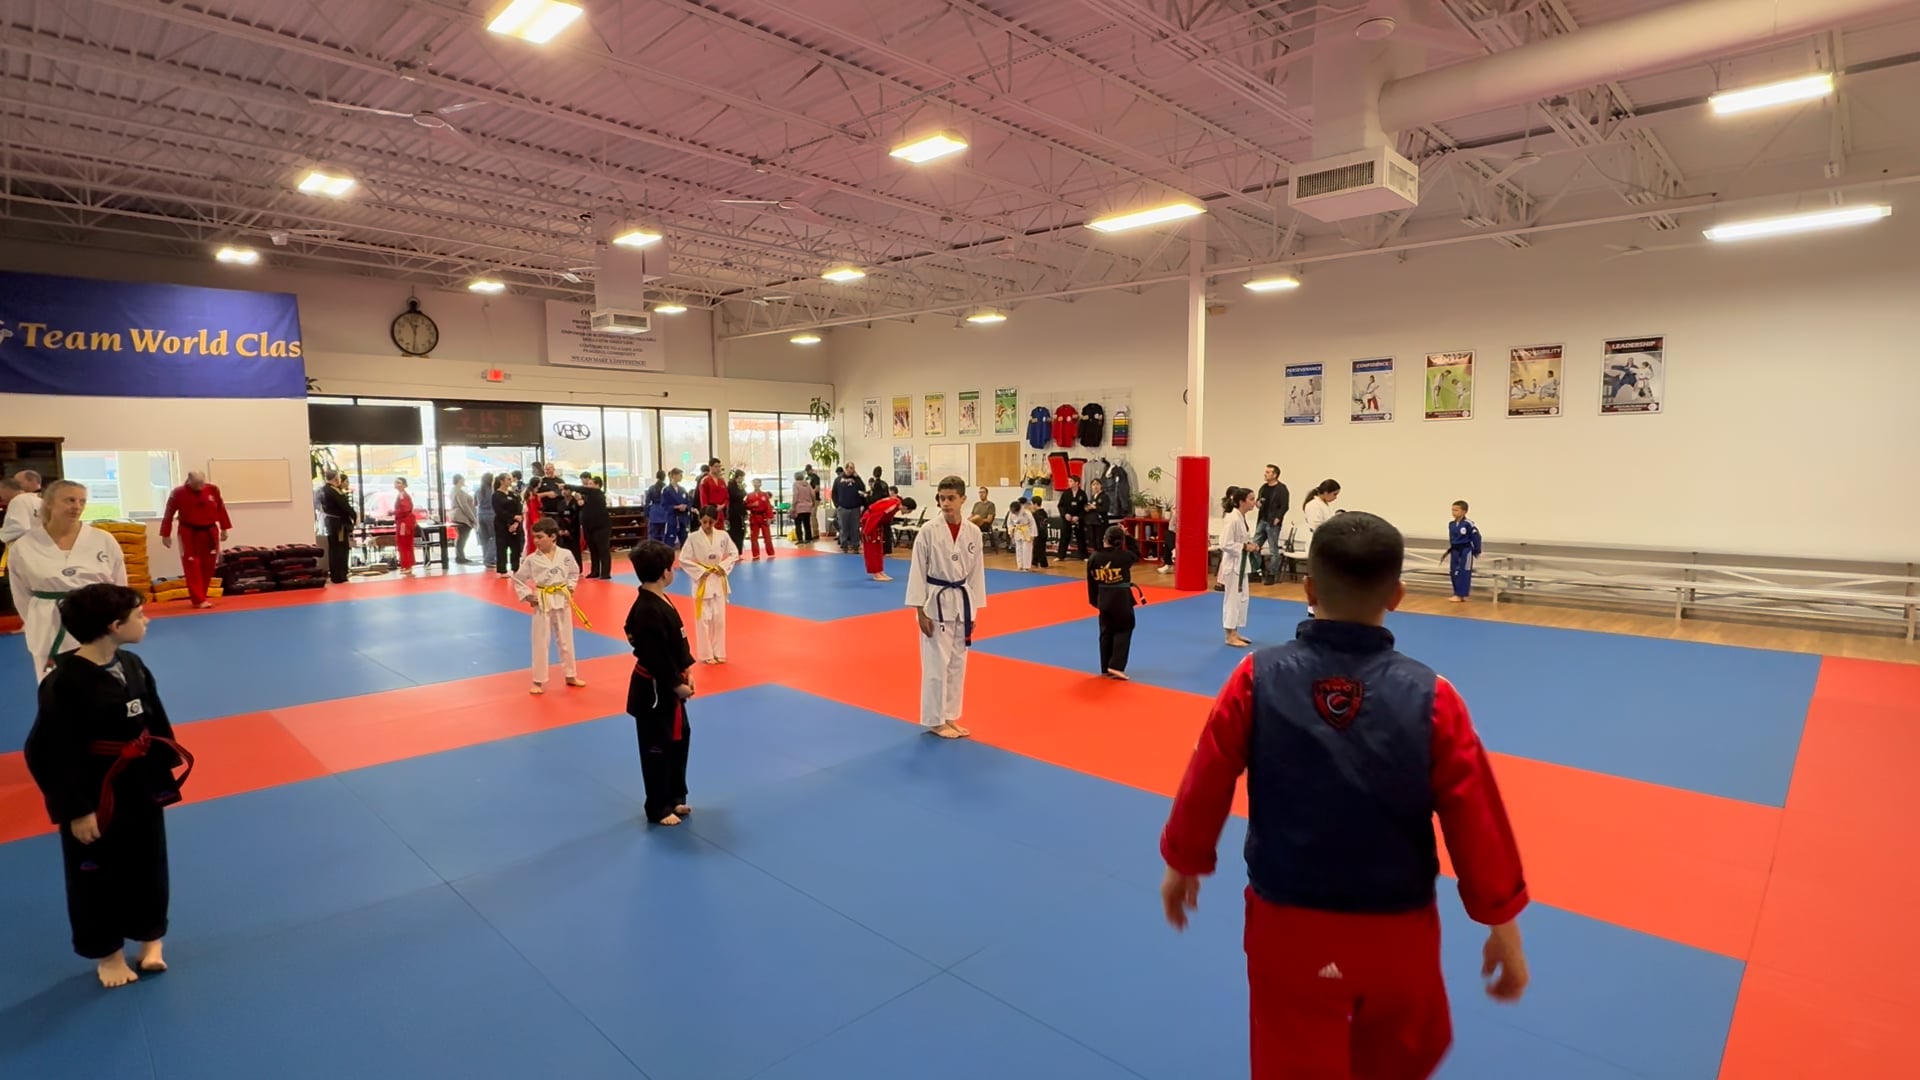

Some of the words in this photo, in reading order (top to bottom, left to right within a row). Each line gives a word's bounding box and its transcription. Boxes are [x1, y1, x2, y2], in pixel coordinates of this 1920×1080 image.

[18, 322, 123, 352] Team
[128, 327, 230, 356] World
[235, 331, 302, 358] Clas
[1611, 341, 1656, 349] LEADERSHIP
[1512, 348, 1561, 357] ROSIBILITY
